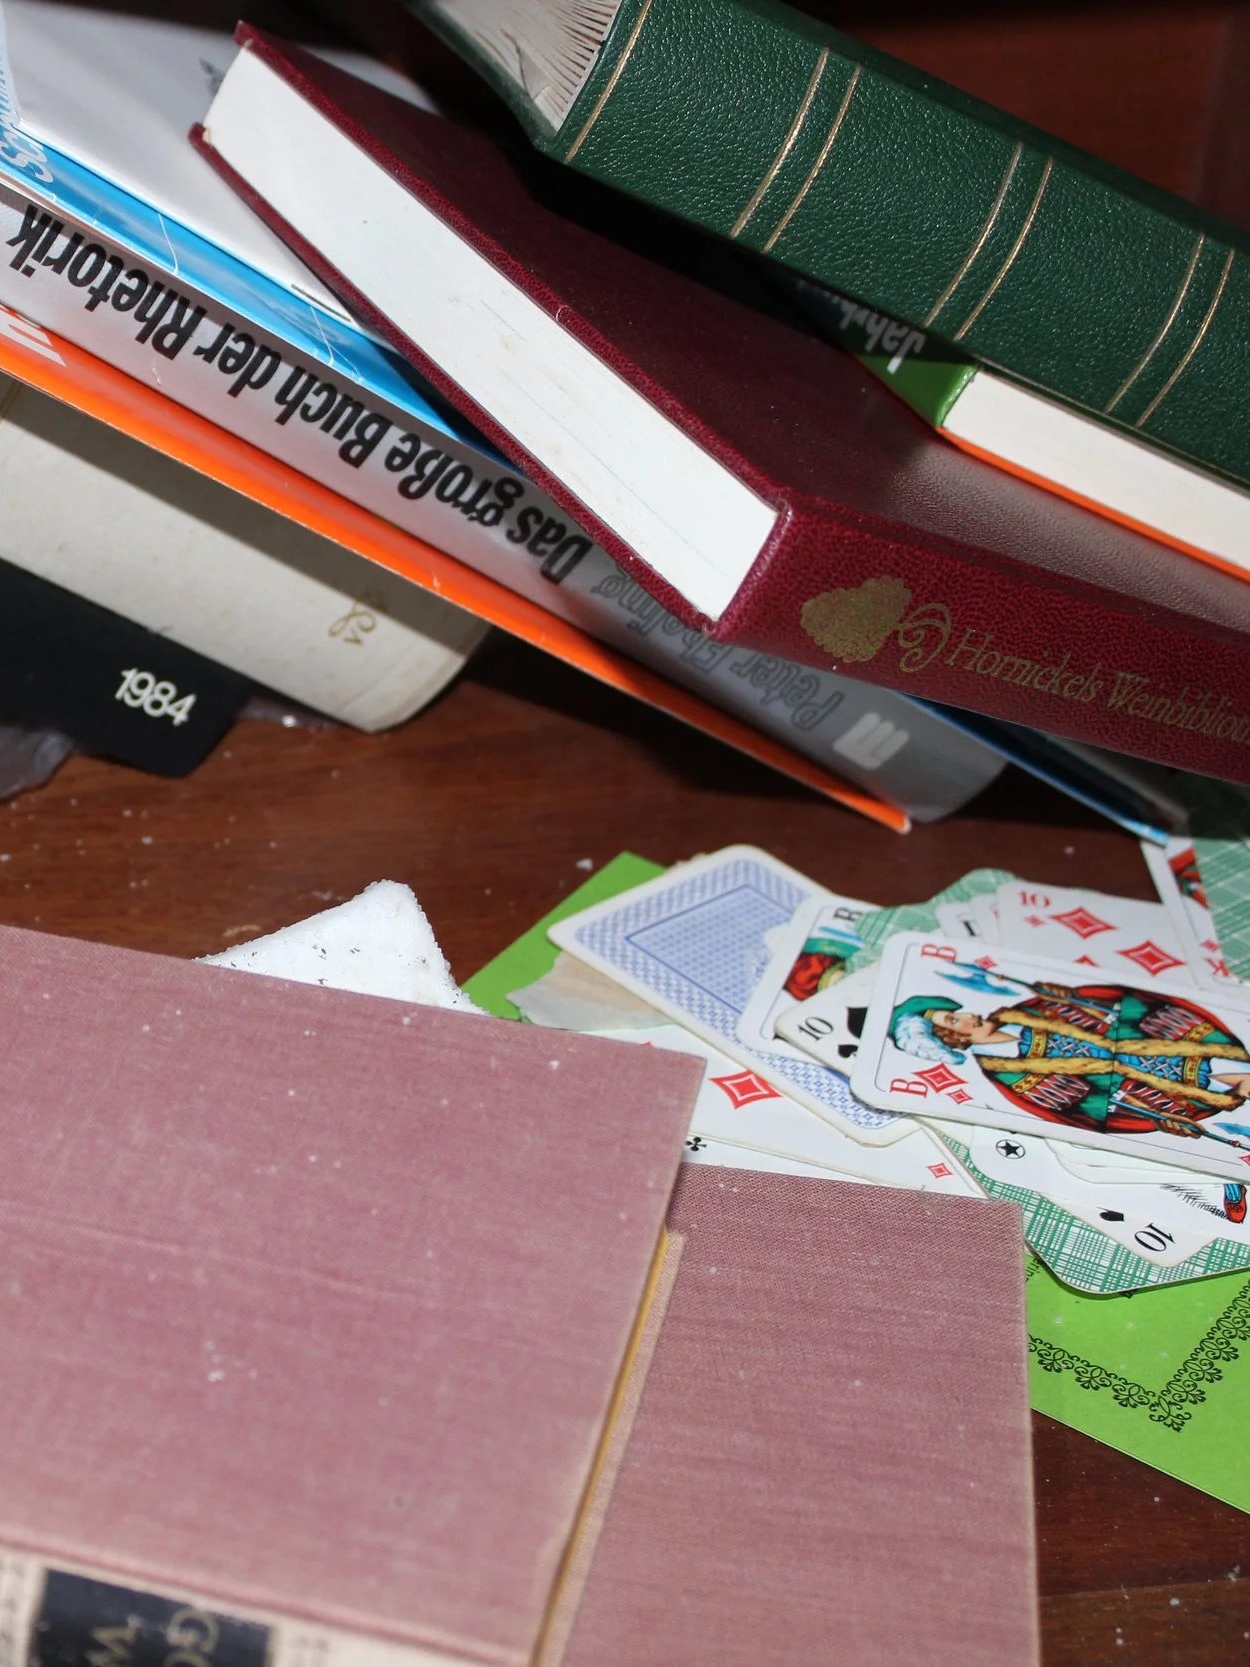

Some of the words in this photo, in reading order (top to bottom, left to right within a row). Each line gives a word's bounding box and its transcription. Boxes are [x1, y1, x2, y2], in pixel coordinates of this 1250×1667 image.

[5, 204, 207, 361] Rhetorik
[193, 315, 275, 398] der
[275, 364, 388, 470] Buch
[385, 431, 524, 529] große
[505, 504, 595, 585] Das
[114, 667, 197, 728] 1984
[729, 650, 844, 732] Peter
[943, 628, 1104, 702] Hornickels
[833, 906, 863, 923] B
[1017, 890, 1052, 908] 10
[920, 943, 957, 962] B
[797, 1016, 834, 1042] 10
[889, 1078, 929, 1099] B
[1134, 1222, 1175, 1253] 10
